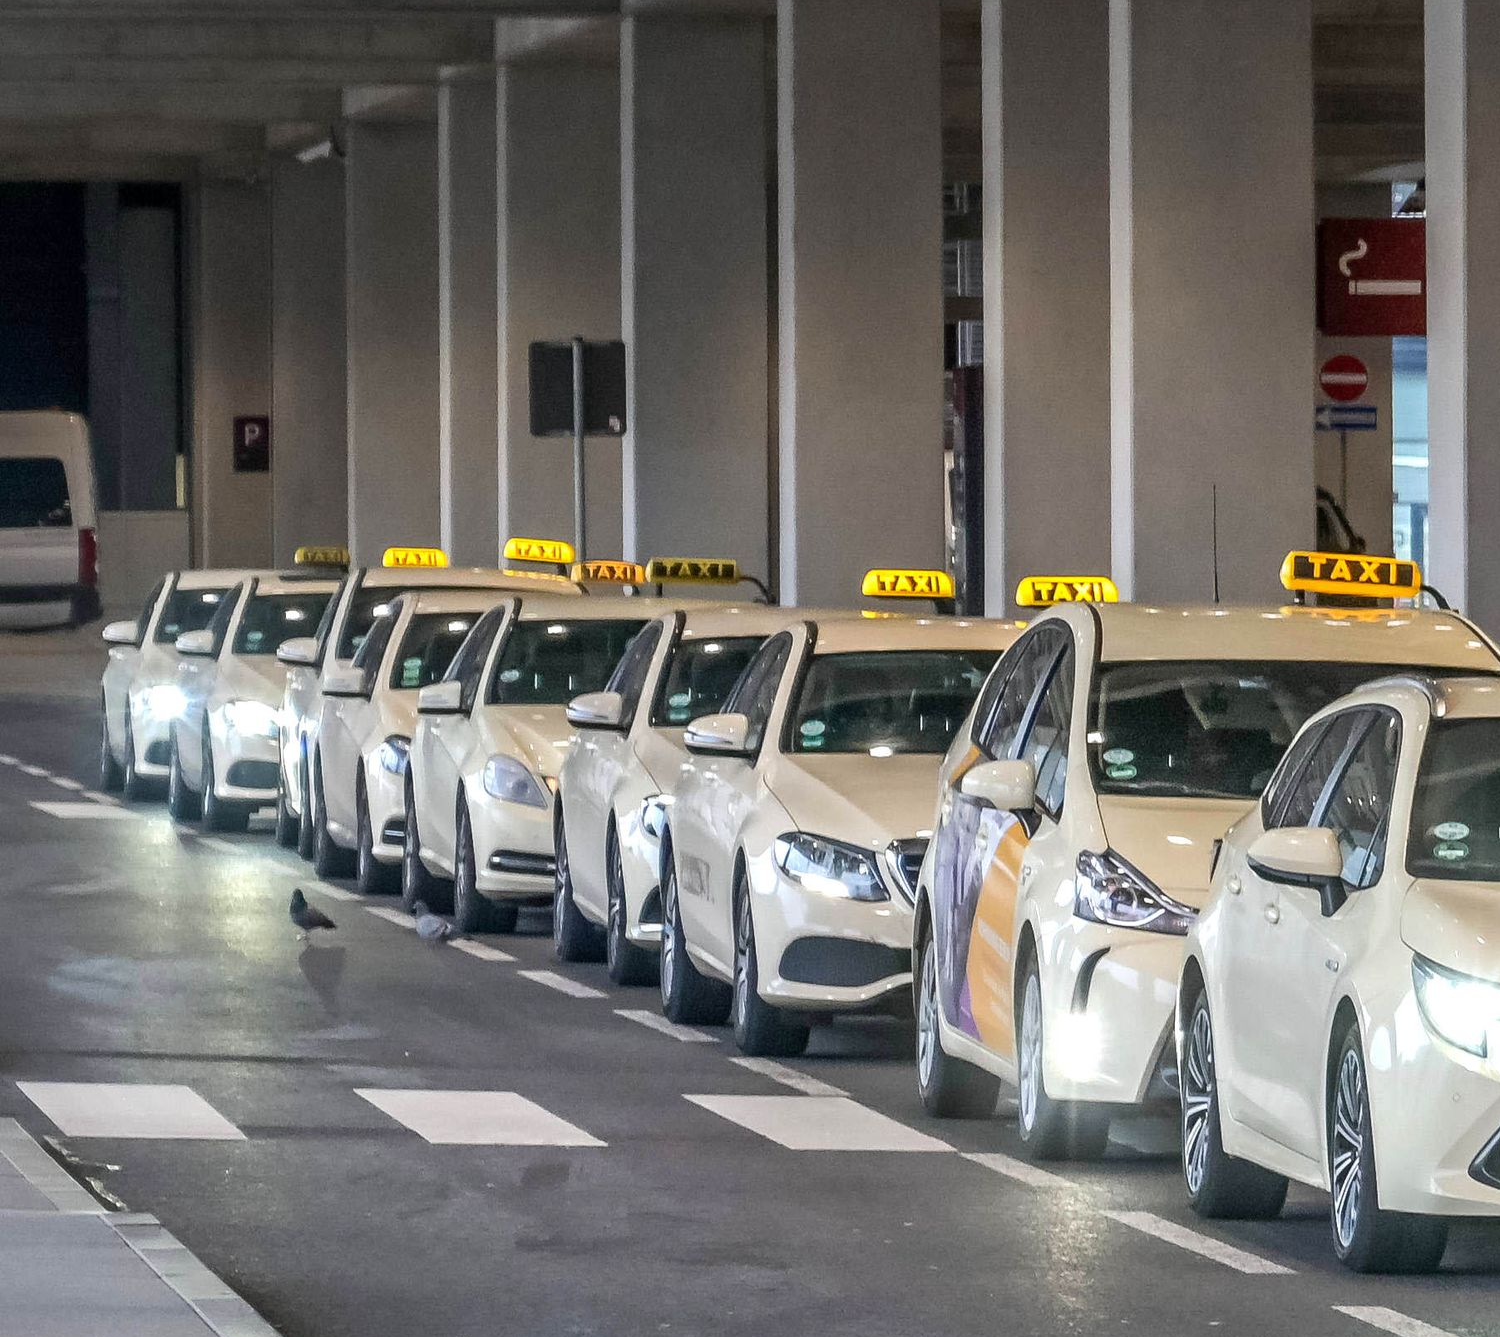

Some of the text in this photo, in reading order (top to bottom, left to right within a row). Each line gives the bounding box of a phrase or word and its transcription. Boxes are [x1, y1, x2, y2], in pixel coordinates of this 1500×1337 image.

[245, 423, 259, 447] P
[395, 550, 436, 566] TAXI
[518, 541, 560, 560] TAXI
[588, 564, 632, 581] TAXI
[665, 562, 723, 577] TAXI
[1308, 556, 1397, 584] TAXI
[879, 575, 939, 592] TAXI
[1035, 582, 1102, 601] TAXI
